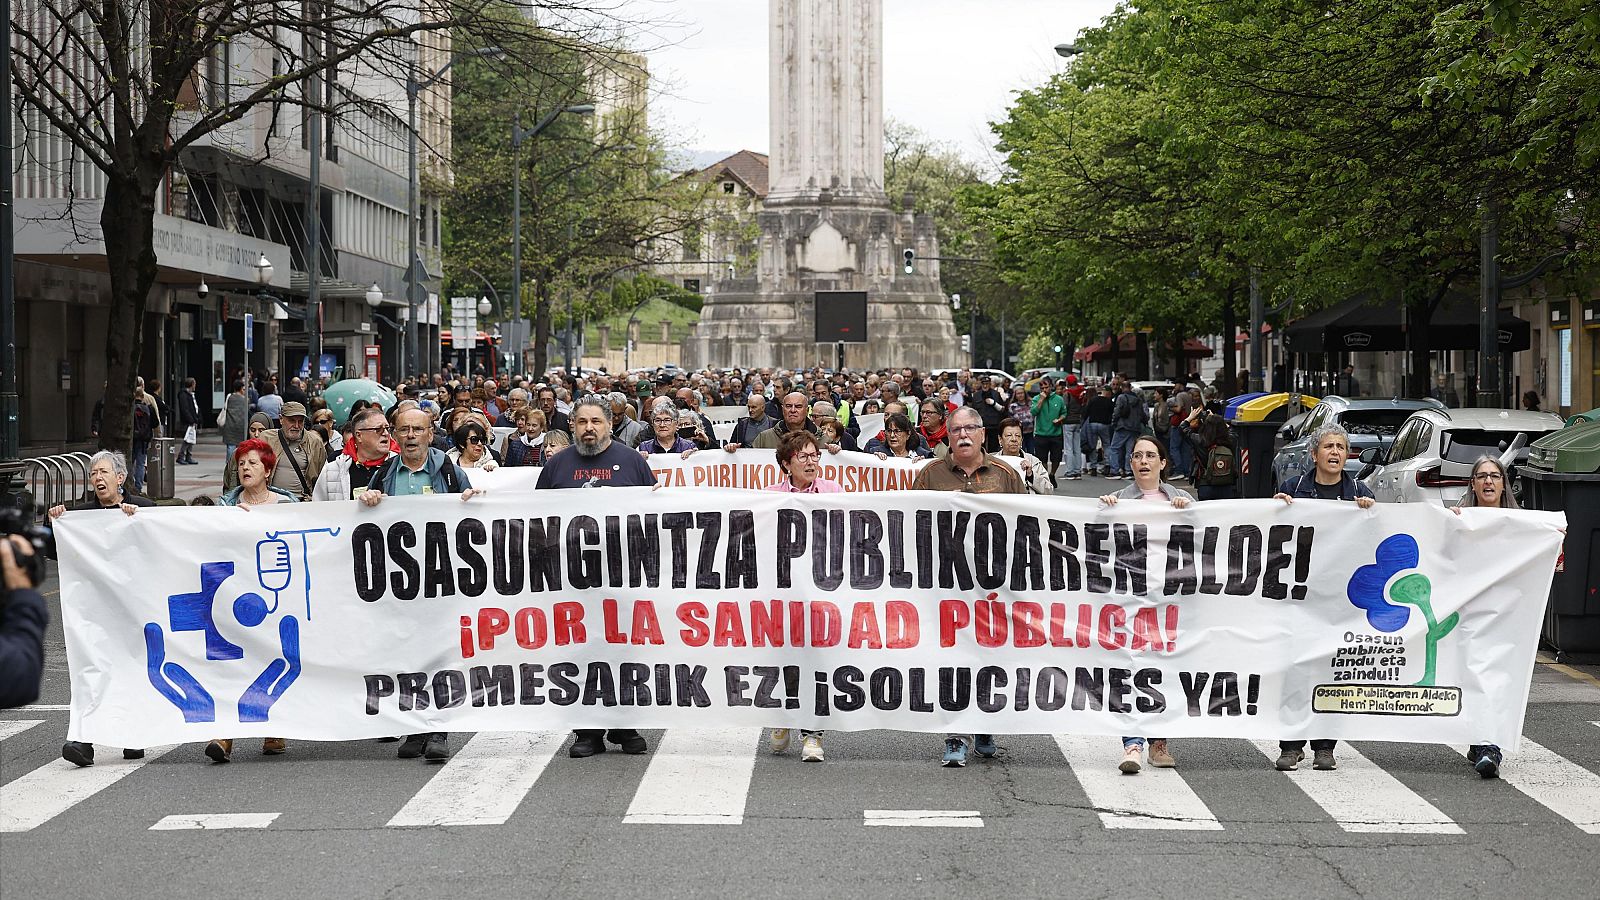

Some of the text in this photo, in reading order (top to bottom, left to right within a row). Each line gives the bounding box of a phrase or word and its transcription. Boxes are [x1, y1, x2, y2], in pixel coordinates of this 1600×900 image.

[351, 508, 1315, 602] OSASUNGINTZA PUBLIKOAREN ALDE!
[459, 592, 1180, 659] ¡POR LA SANIDAD PÚBLICA!
[1343, 631, 1404, 646] Osasun
[1336, 645, 1406, 658] publikoa
[1331, 655, 1407, 667] landu eta
[1333, 667, 1400, 681] zaindu!!
[363, 661, 1261, 717] PROMESARIK EZ! ¡SOLUCIONES YA!
[1316, 688, 1355, 698] Osasun
[1356, 687, 1419, 700] Publikoaren
